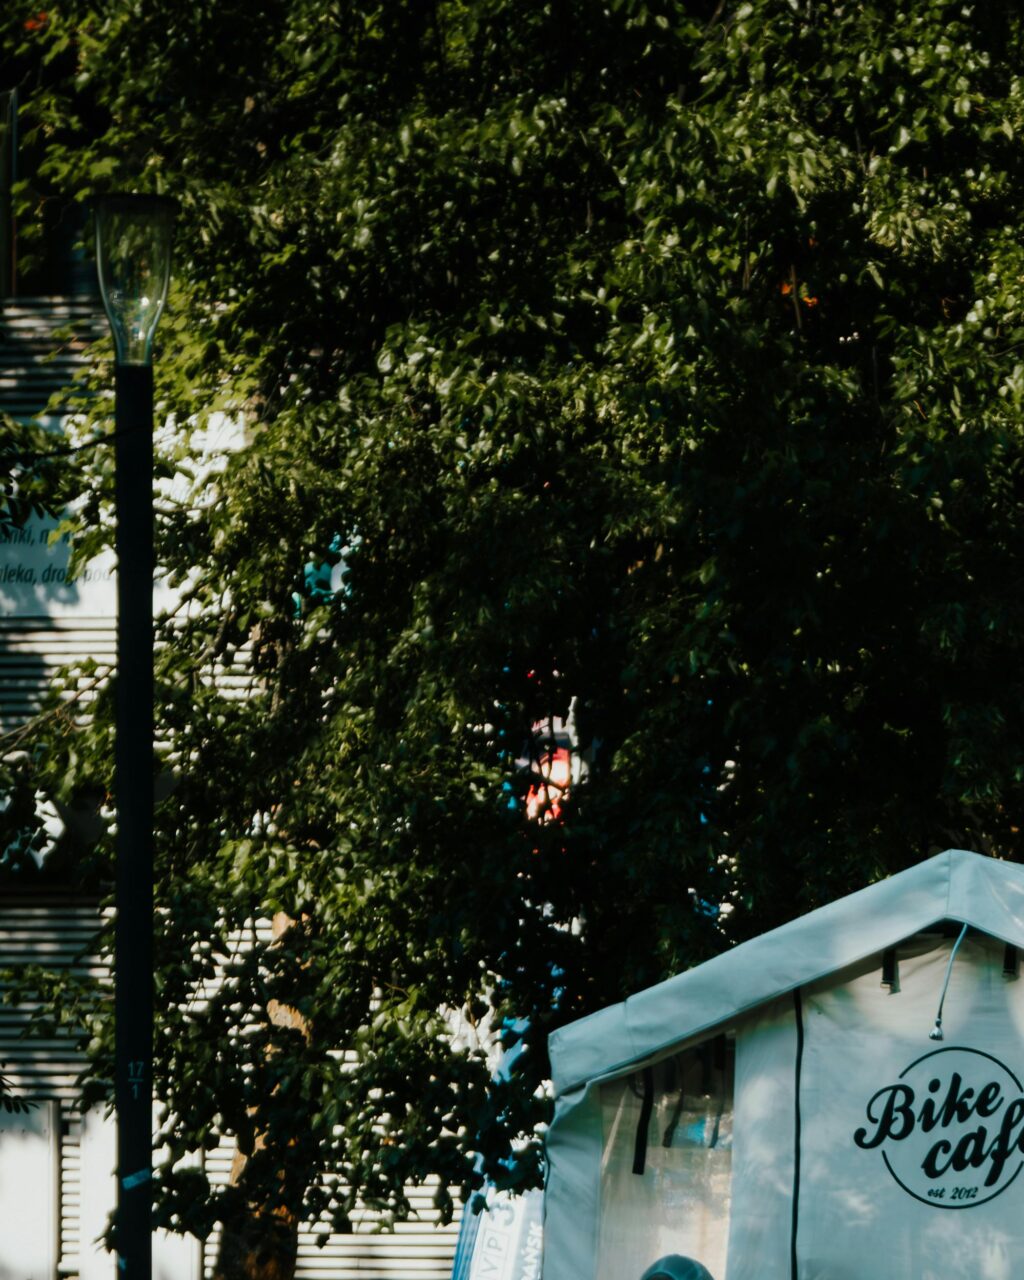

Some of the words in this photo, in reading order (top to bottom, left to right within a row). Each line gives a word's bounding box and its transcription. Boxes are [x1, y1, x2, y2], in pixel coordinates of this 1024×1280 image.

[0, 563, 37, 585] leka,
[128, 1061, 144, 1077] 17
[131, 1084, 139, 1100] 1
[854, 1072, 1004, 1149] Bike
[927, 1187, 945, 1198] est
[950, 1186, 978, 1200] 2012
